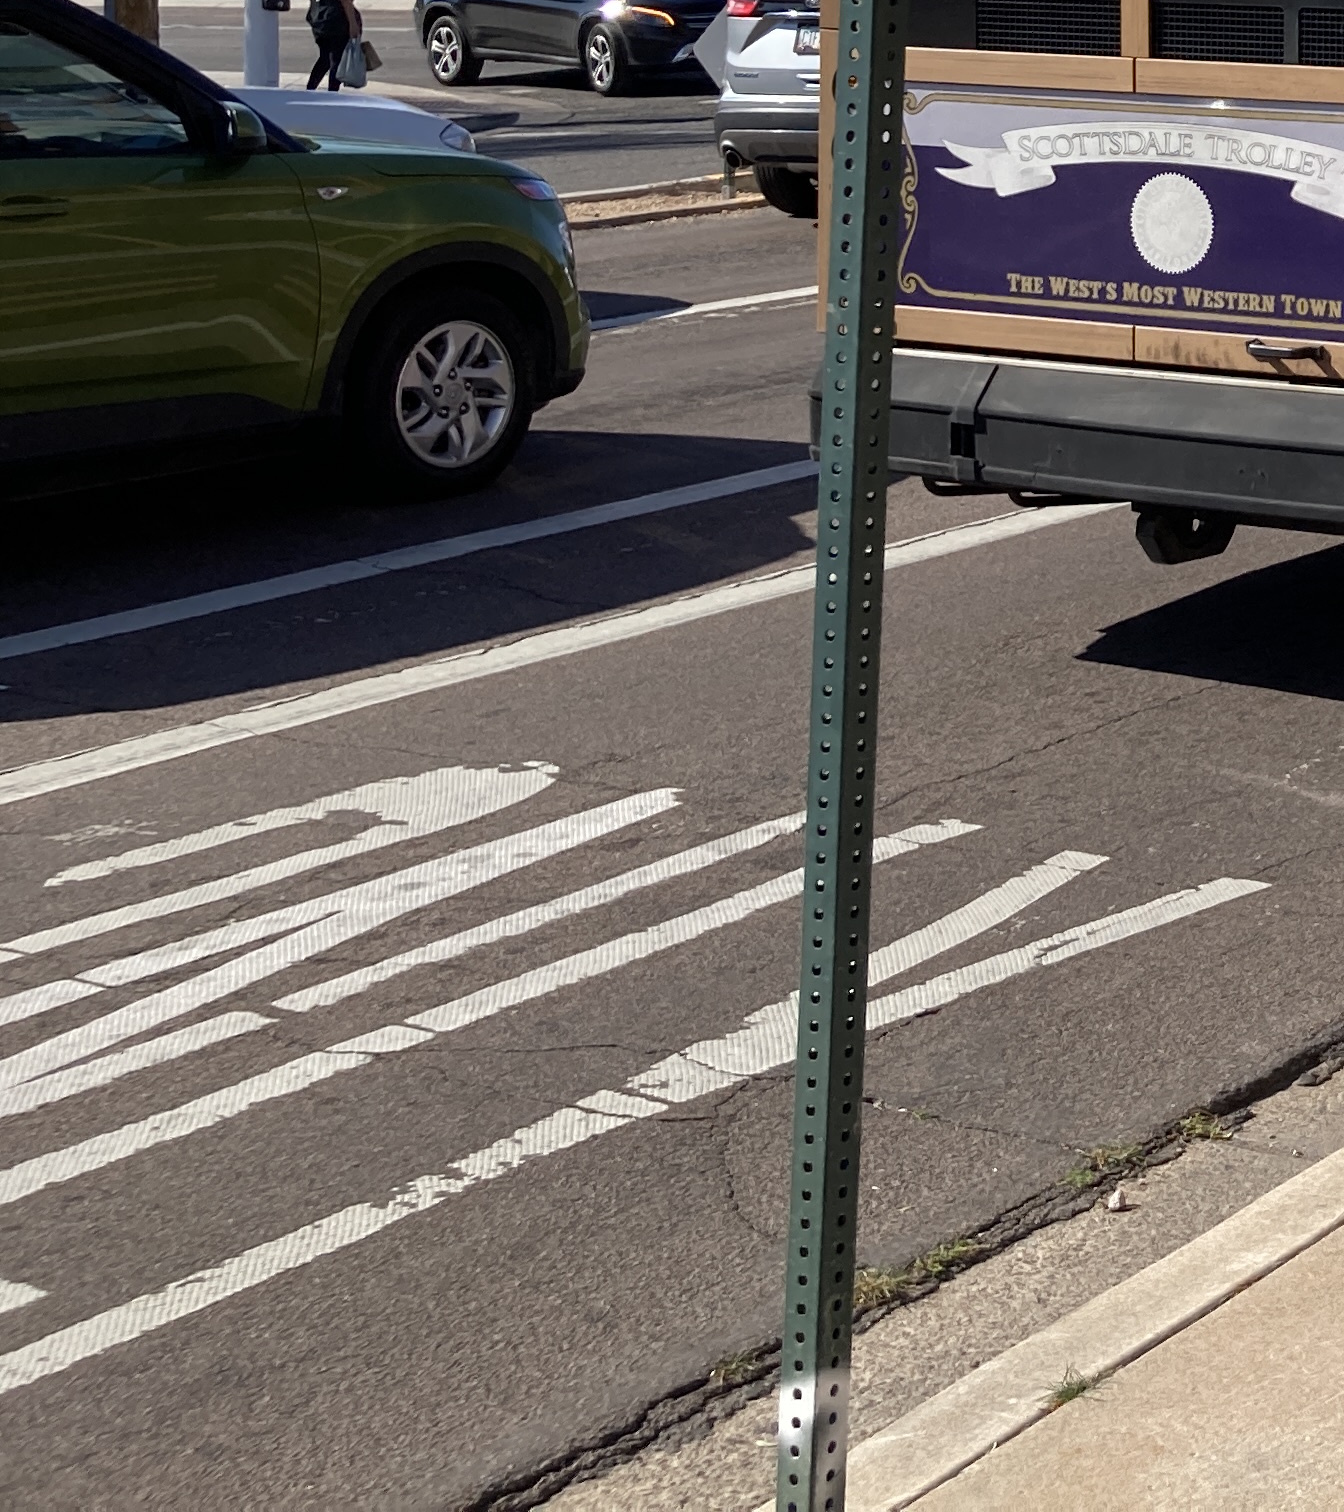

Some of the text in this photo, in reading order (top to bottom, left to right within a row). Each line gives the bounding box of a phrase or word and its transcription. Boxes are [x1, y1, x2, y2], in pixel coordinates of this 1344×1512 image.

[1018, 131, 1338, 180] SCOTTSDALE TROLLEY
[1006, 272, 1343, 319] THE WEST'S MOST WESTERN TOWN
